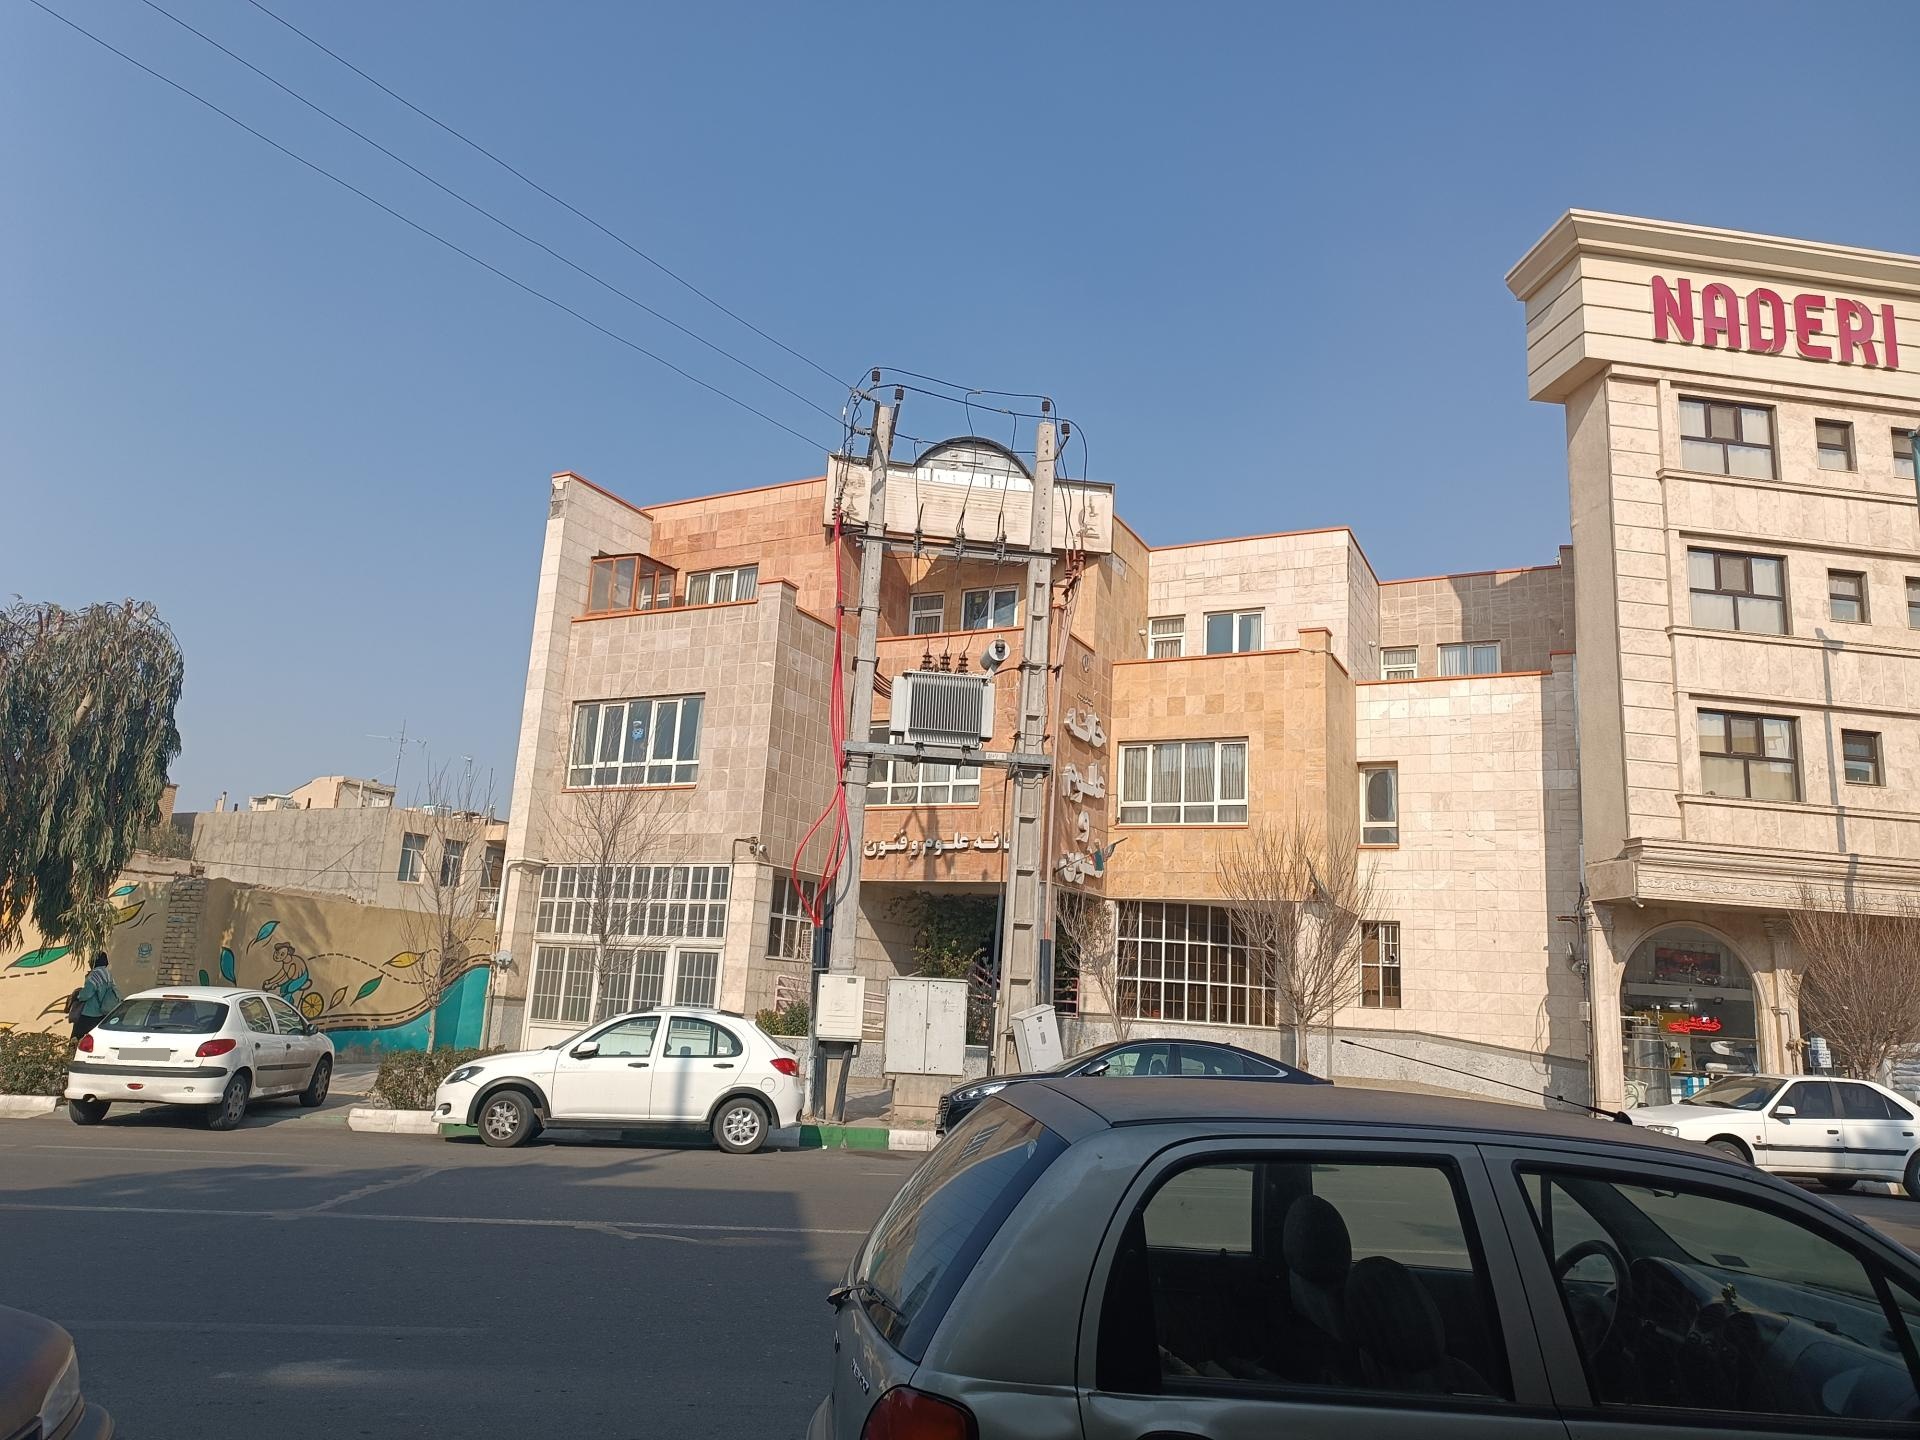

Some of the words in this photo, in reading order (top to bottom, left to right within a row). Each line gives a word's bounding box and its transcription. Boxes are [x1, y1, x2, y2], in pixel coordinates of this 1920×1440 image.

[1651, 275, 1898, 368] NADERI
[1064, 708, 1107, 748] خانه
[1061, 763, 1105, 803] علوم
[974, 831, 1010, 850] انه
[1076, 811, 1090, 843] و
[863, 829, 908, 857] فنون
[911, 840, 919, 856] و
[922, 832, 969, 856] علوم
